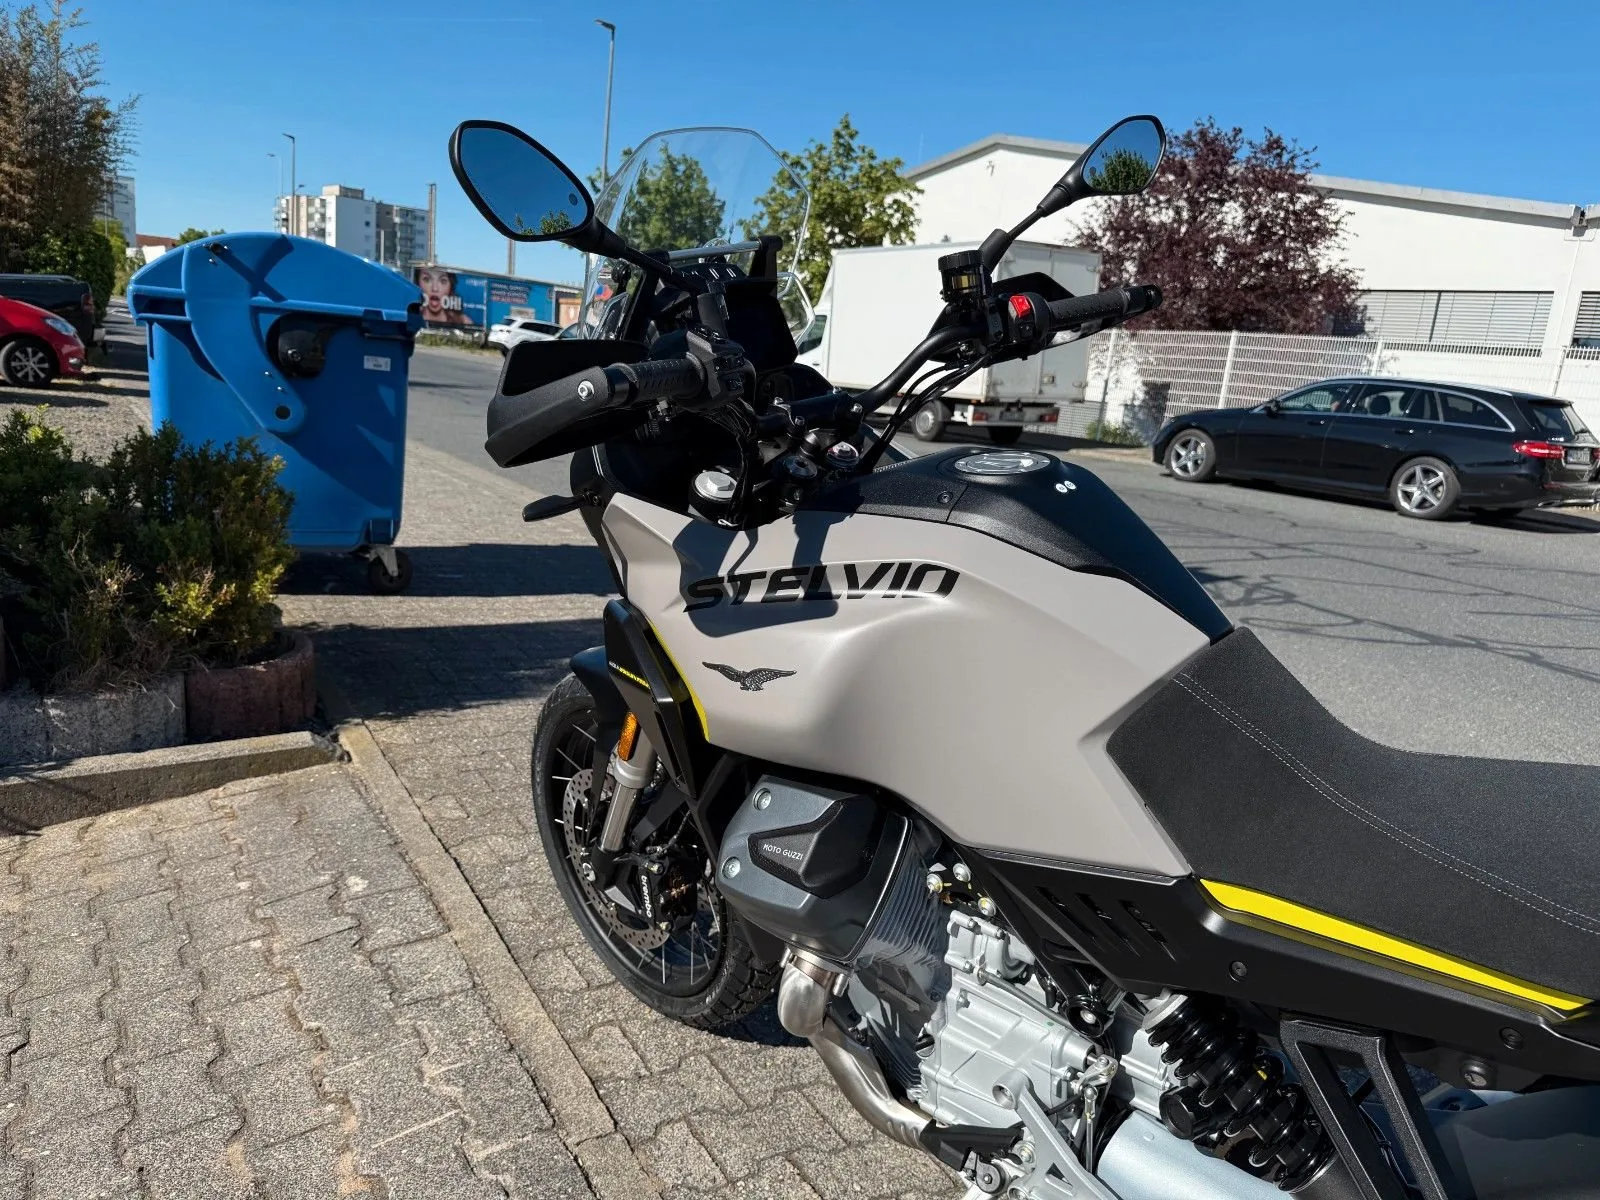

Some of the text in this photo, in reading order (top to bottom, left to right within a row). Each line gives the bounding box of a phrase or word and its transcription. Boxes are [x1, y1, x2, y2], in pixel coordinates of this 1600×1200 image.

[683, 562, 960, 613] STELVIO
[762, 843, 804, 861] MOTO GUZZI
[641, 875, 652, 918] brembo
